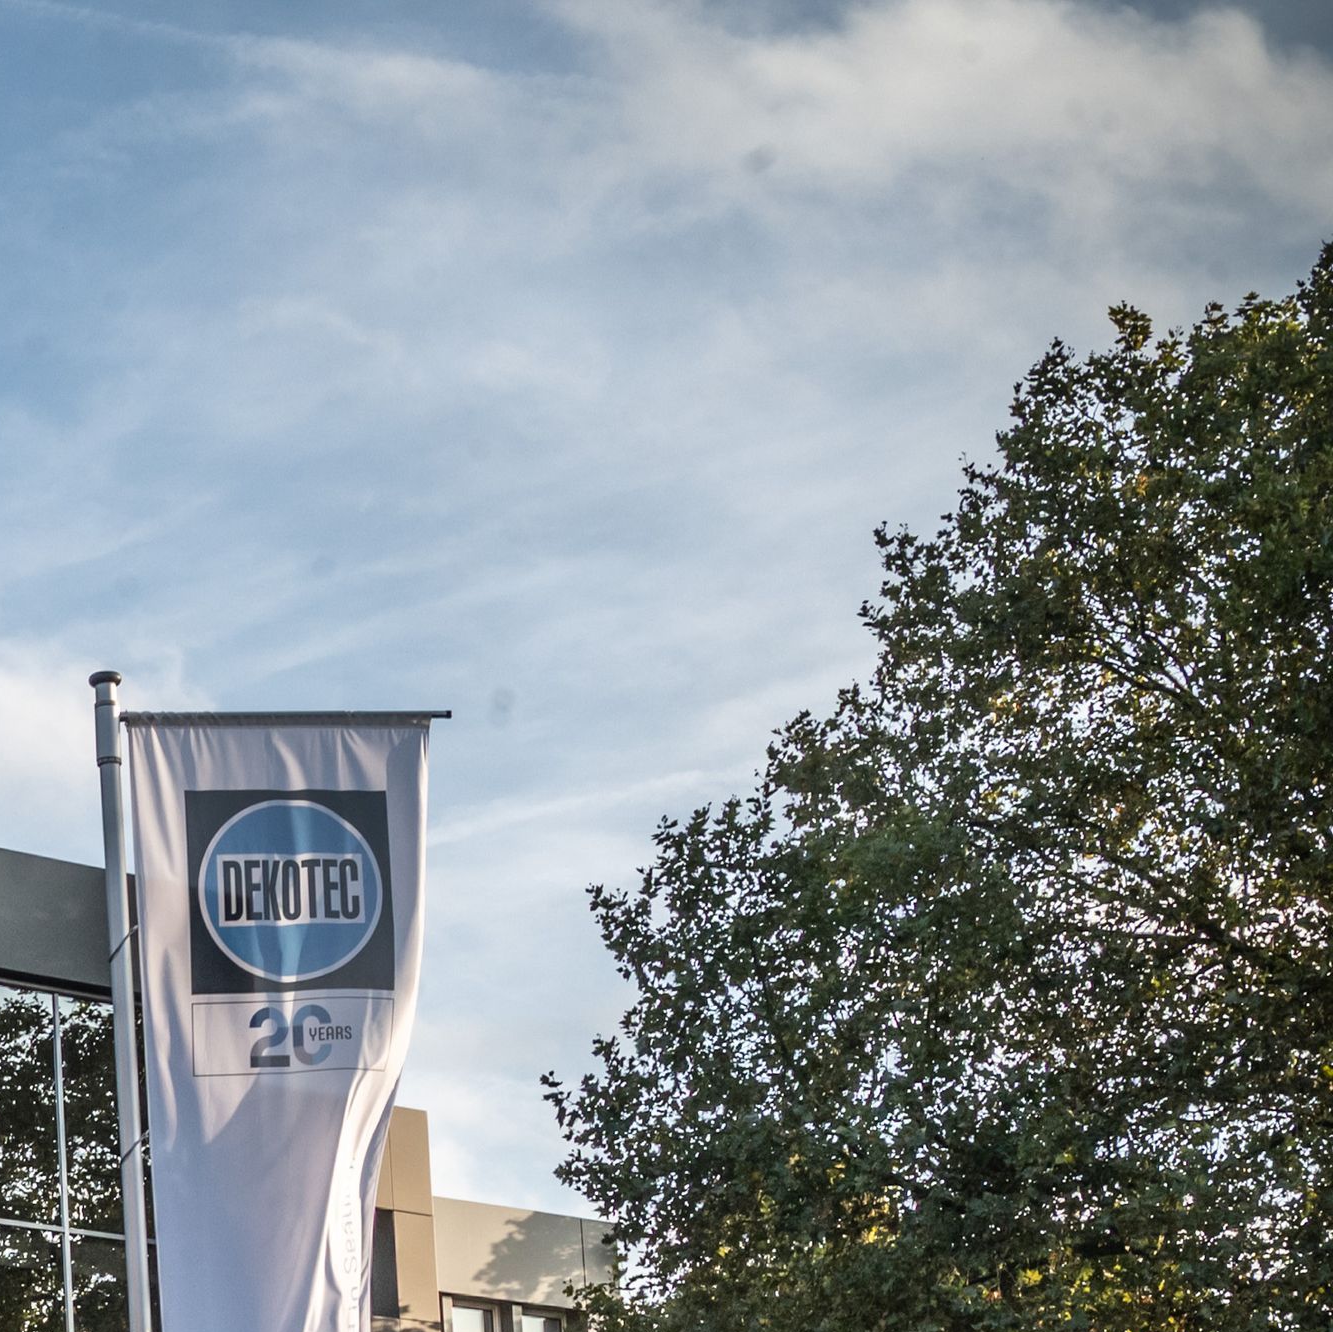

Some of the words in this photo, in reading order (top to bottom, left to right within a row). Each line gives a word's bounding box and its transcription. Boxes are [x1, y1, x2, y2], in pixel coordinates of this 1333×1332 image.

[222, 858, 361, 922] DEKOTEC
[249, 1004, 332, 1068] 20
[308, 1025, 353, 1042] YEARS
